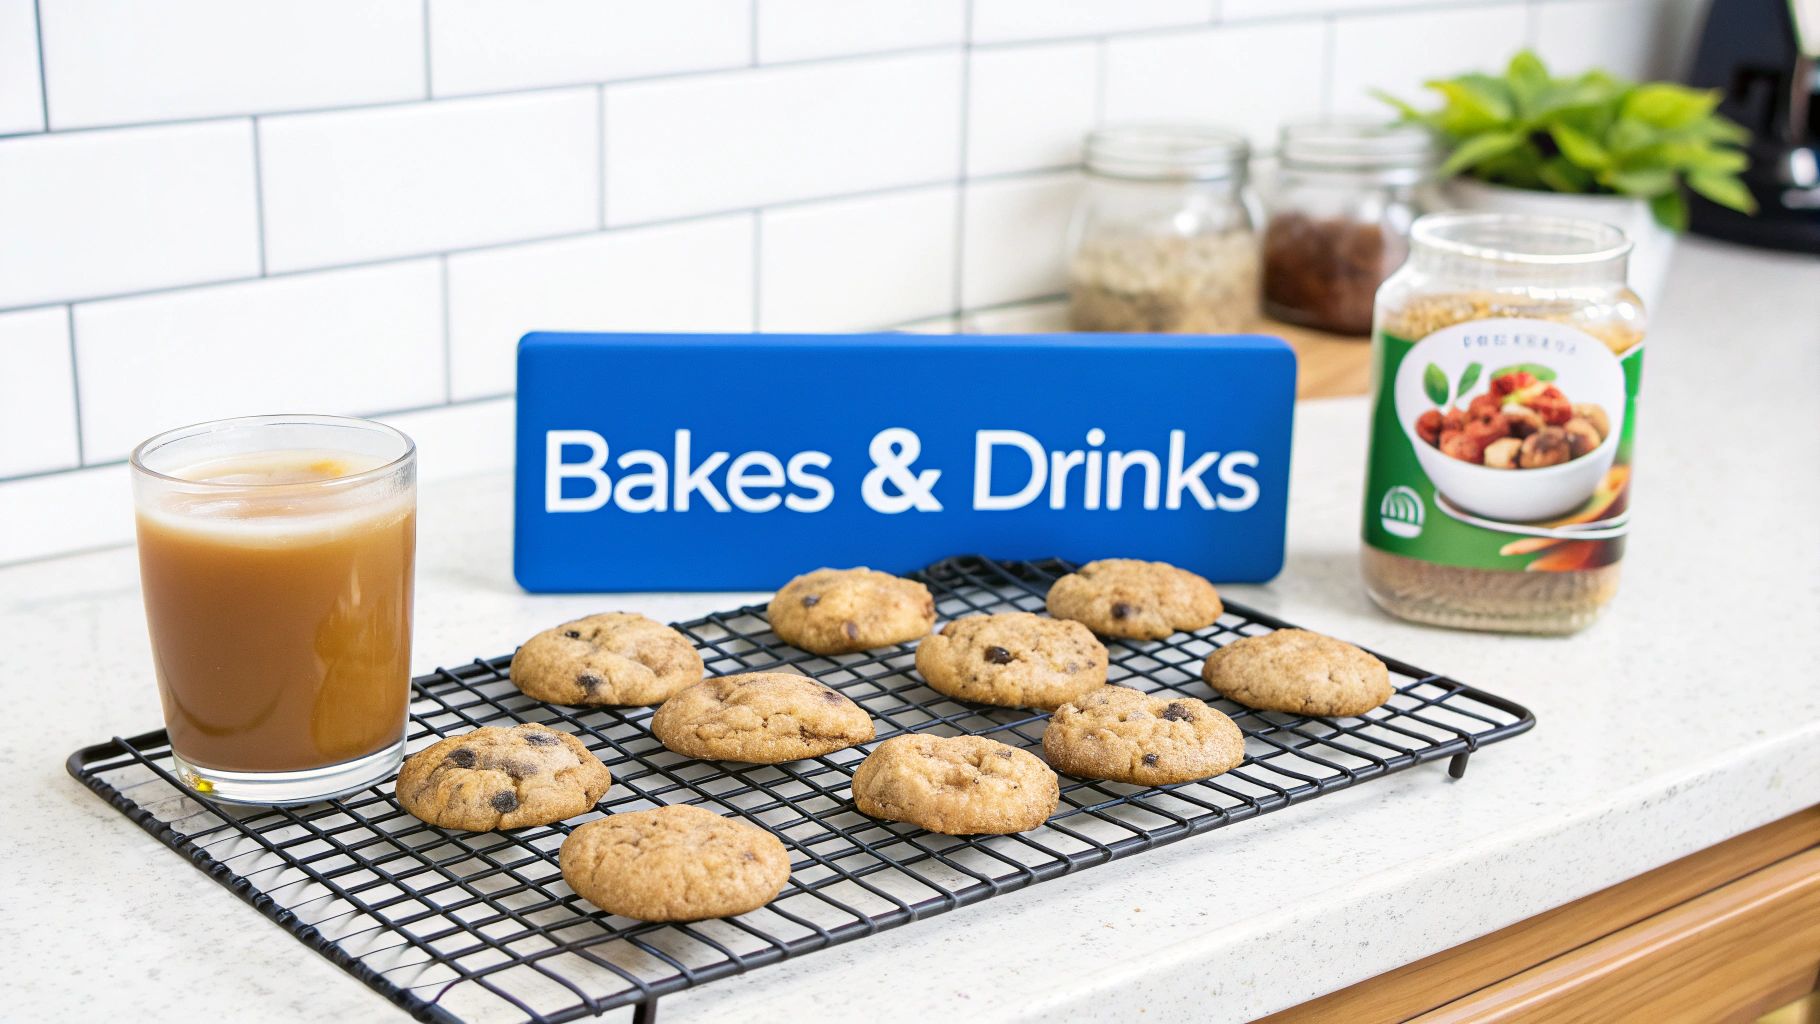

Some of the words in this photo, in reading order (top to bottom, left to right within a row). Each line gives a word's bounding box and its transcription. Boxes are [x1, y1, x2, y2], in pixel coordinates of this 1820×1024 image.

[545, 430, 834, 513] Bakes
[861, 427, 943, 514] &
[973, 428, 1259, 511] Drinks
